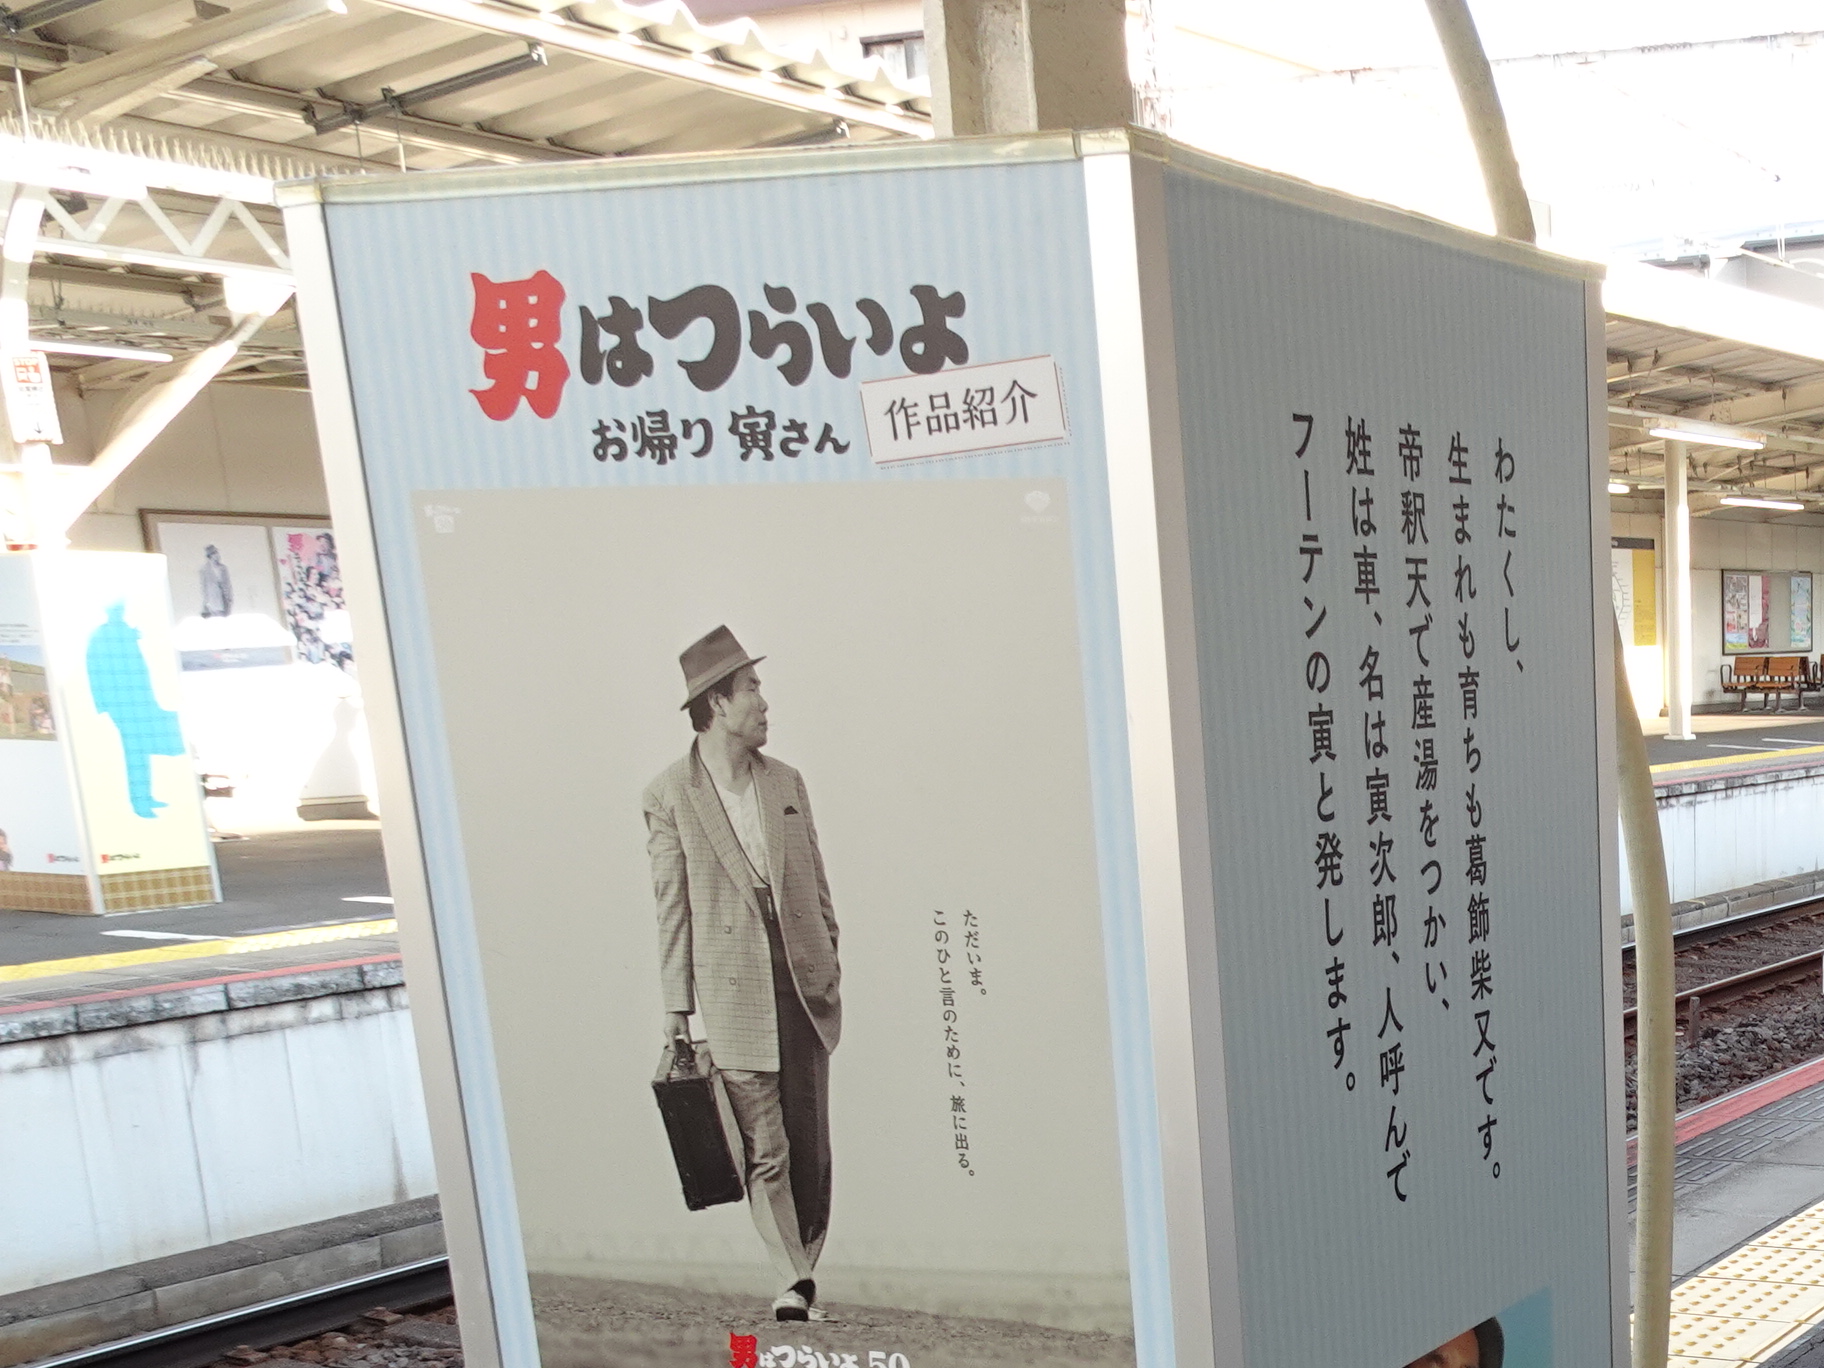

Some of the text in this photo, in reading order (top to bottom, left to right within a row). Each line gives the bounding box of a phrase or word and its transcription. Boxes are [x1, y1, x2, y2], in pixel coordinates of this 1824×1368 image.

[468, 269, 970, 421] 男はつらいよ
[883, 378, 1039, 442] 作品紹介
[1493, 435, 1524, 675] わたくし、
[1291, 411, 1357, 1093] フーテンの寅と発します。
[1344, 414, 1408, 1203] 姓は車、名は寅次郎、人呼んで
[1398, 423, 1450, 1011] 帝釈天で産湯をつかい、
[1446, 430, 1502, 1181] 生まれも育ちも葛飾柴又です。
[933, 909, 975, 1177] このひと言のために、旅に出る。
[963, 908, 987, 996] ただいま。
